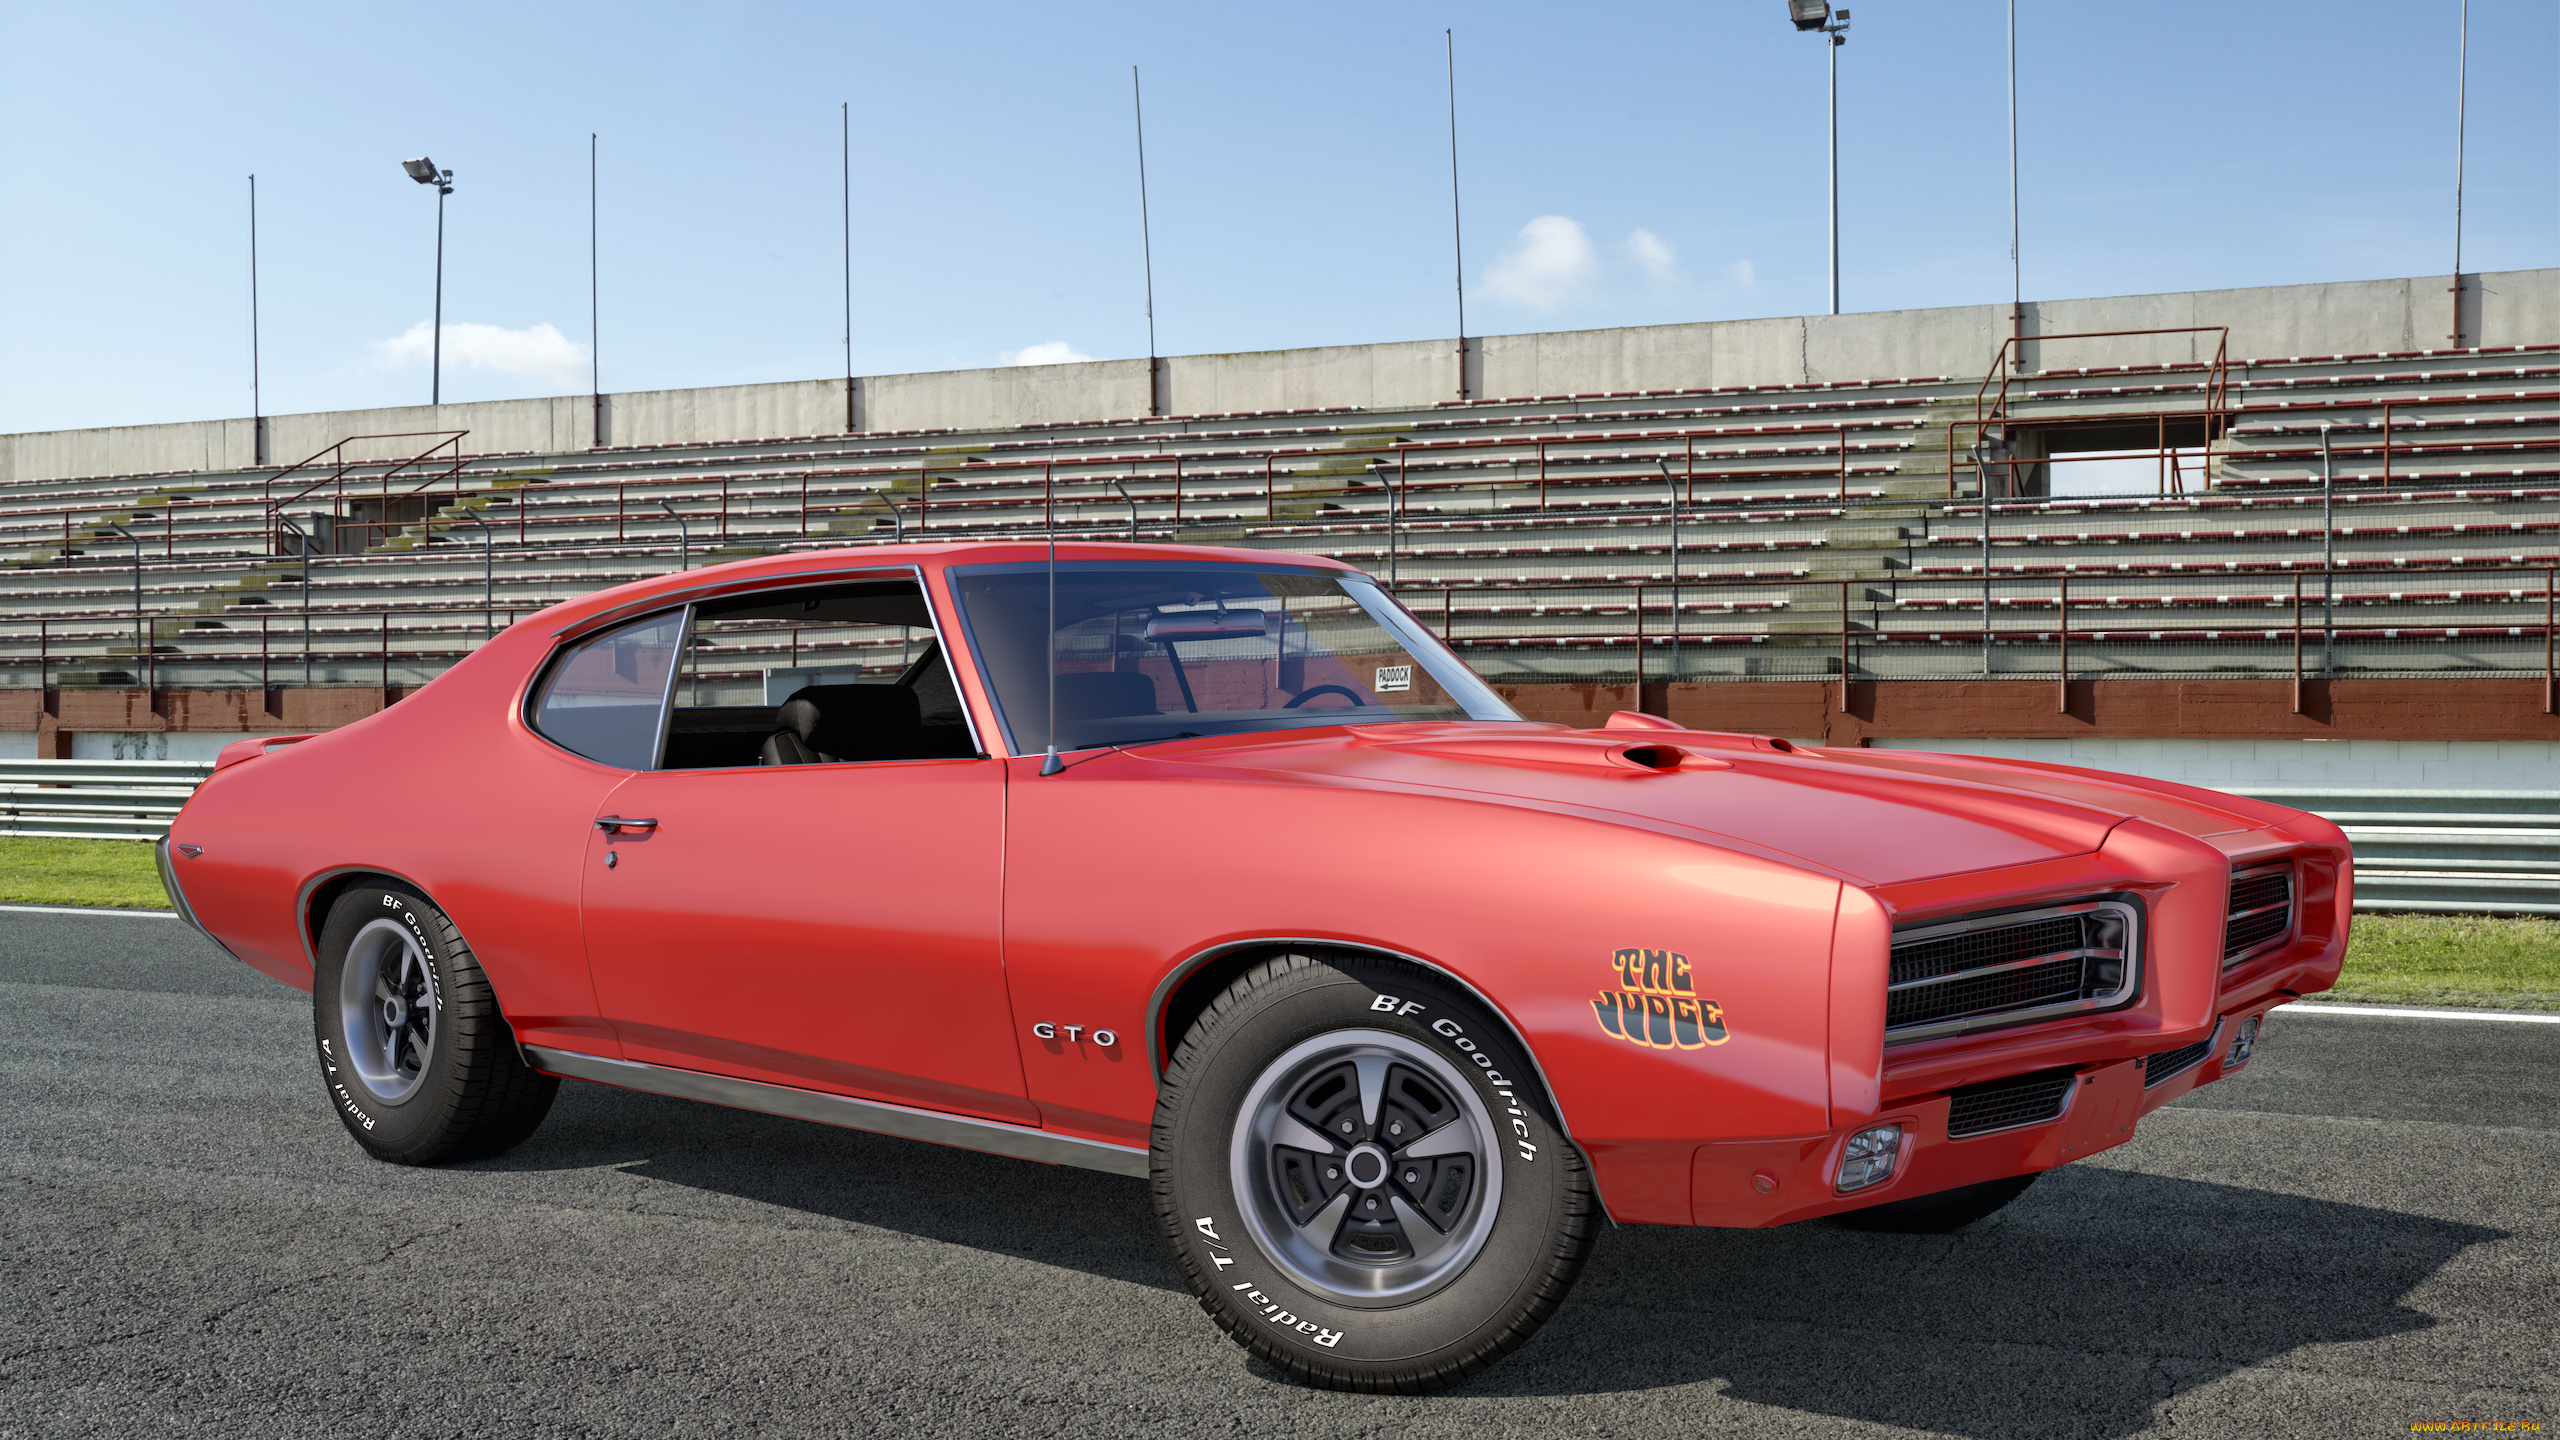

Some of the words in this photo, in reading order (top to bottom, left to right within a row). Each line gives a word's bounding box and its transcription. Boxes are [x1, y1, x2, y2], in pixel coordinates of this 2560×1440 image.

[1379, 667, 1409, 682] PADDOCK
[383, 895, 402, 910] BF
[405, 912, 443, 1011] Goodrich
[1612, 947, 1696, 996] THE
[1033, 1022, 1115, 1047] GTO
[1589, 990, 1730, 1050] JUDGE
[322, 1039, 337, 1076] T/A
[1370, 994, 1426, 1016] BF
[1432, 1018, 1537, 1162] Goodrich
[335, 1083, 376, 1130] Radial
[1195, 1216, 1235, 1272] T/A
[1232, 1282, 1345, 1348] Radial
